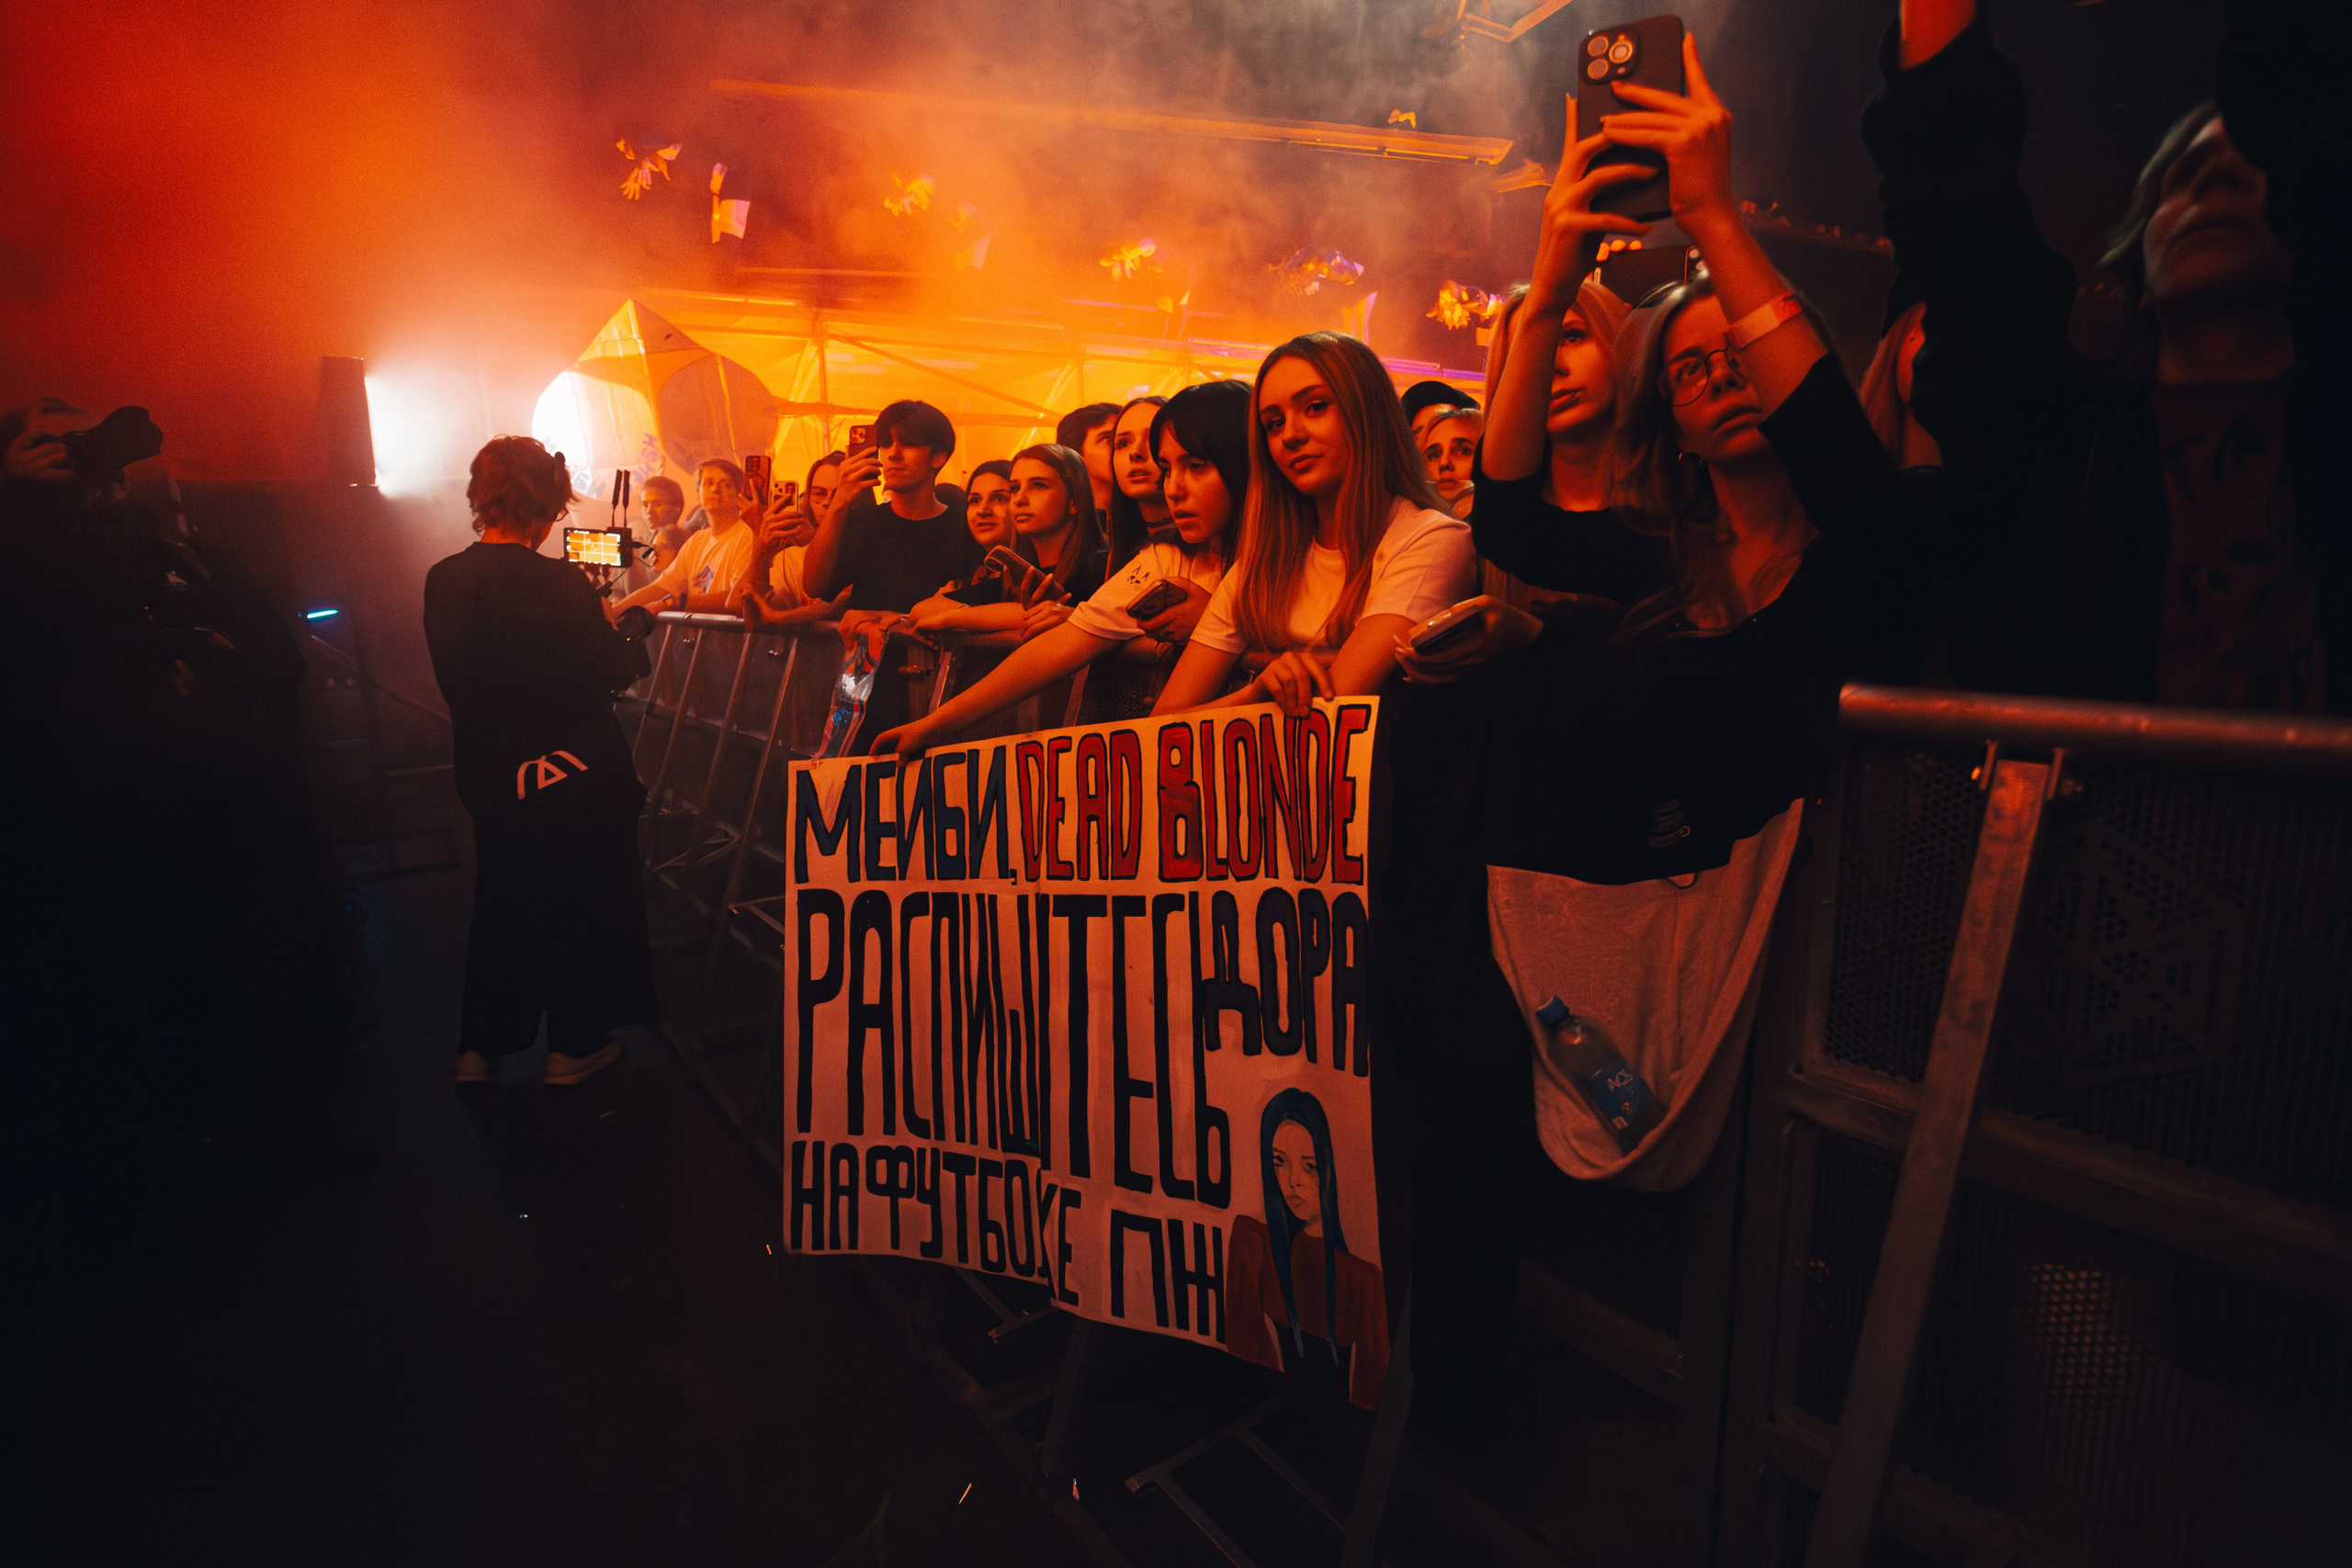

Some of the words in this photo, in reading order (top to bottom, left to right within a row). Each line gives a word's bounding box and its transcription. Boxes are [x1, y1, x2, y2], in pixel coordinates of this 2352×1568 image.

[1015, 728, 1142, 883] DEAD
[1158, 704, 1372, 886] BLONDE
[1203, 886, 1370, 1077] ДОРА
[1110, 1208, 1227, 1345] ПЖ
